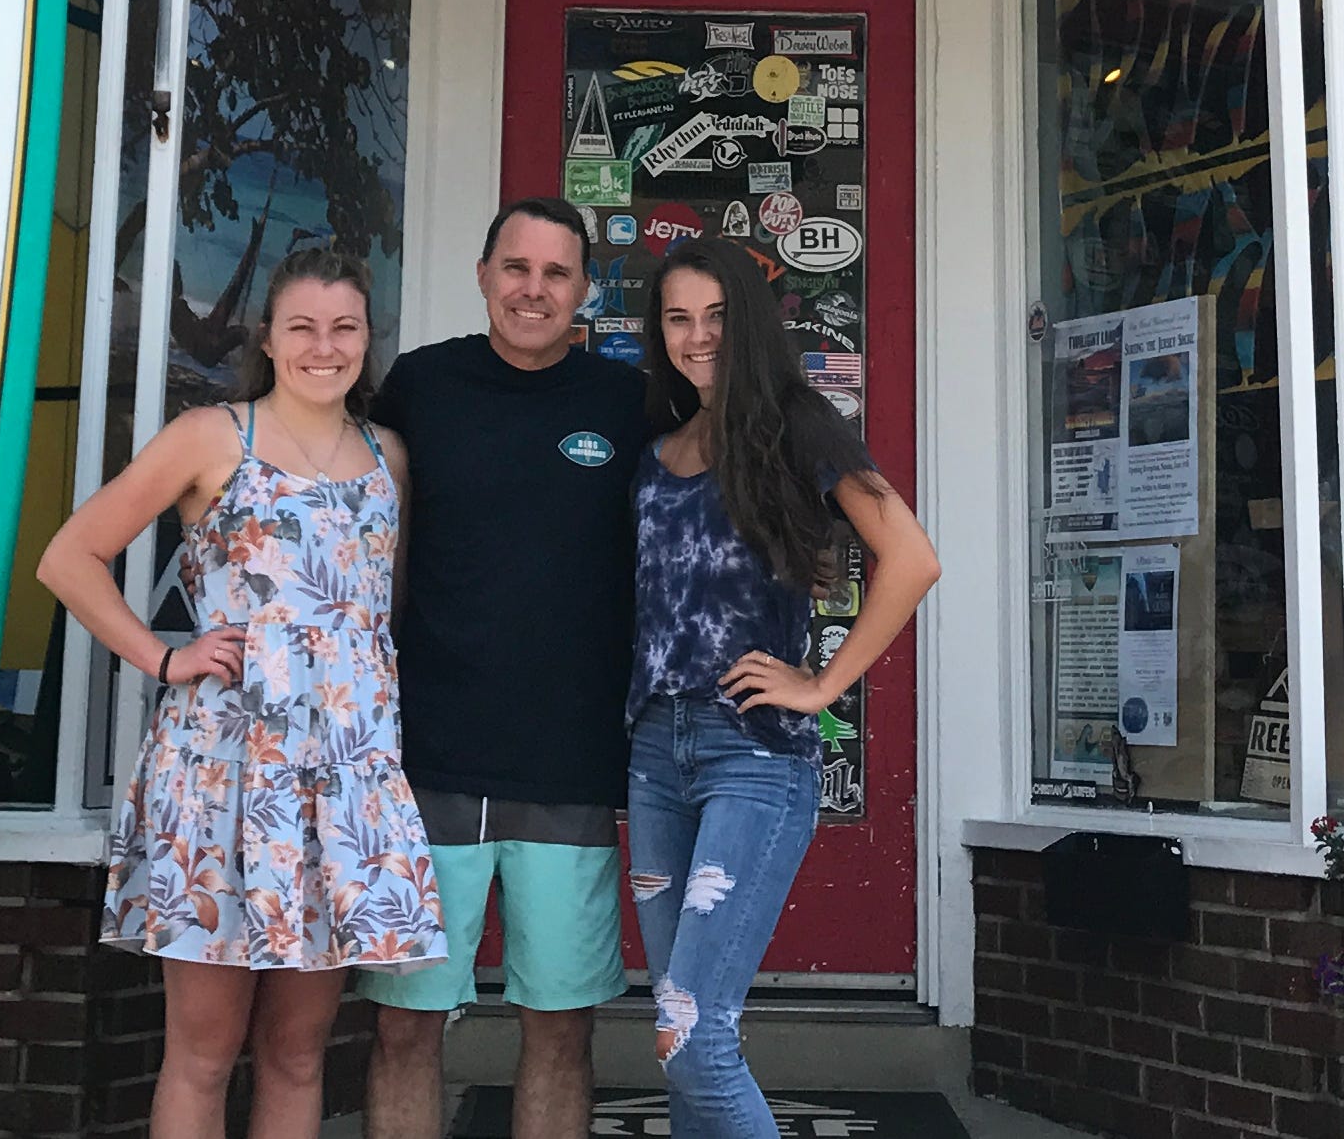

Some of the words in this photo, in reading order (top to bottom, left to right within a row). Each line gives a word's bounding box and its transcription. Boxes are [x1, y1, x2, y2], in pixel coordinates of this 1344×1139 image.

[816, 35, 850, 51] Weber
[818, 64, 856, 84] TOES
[816, 83, 859, 100] NOSE
[769, 195, 801, 212] POP
[799, 227, 840, 249] BH
[816, 302, 859, 320] patagonia
